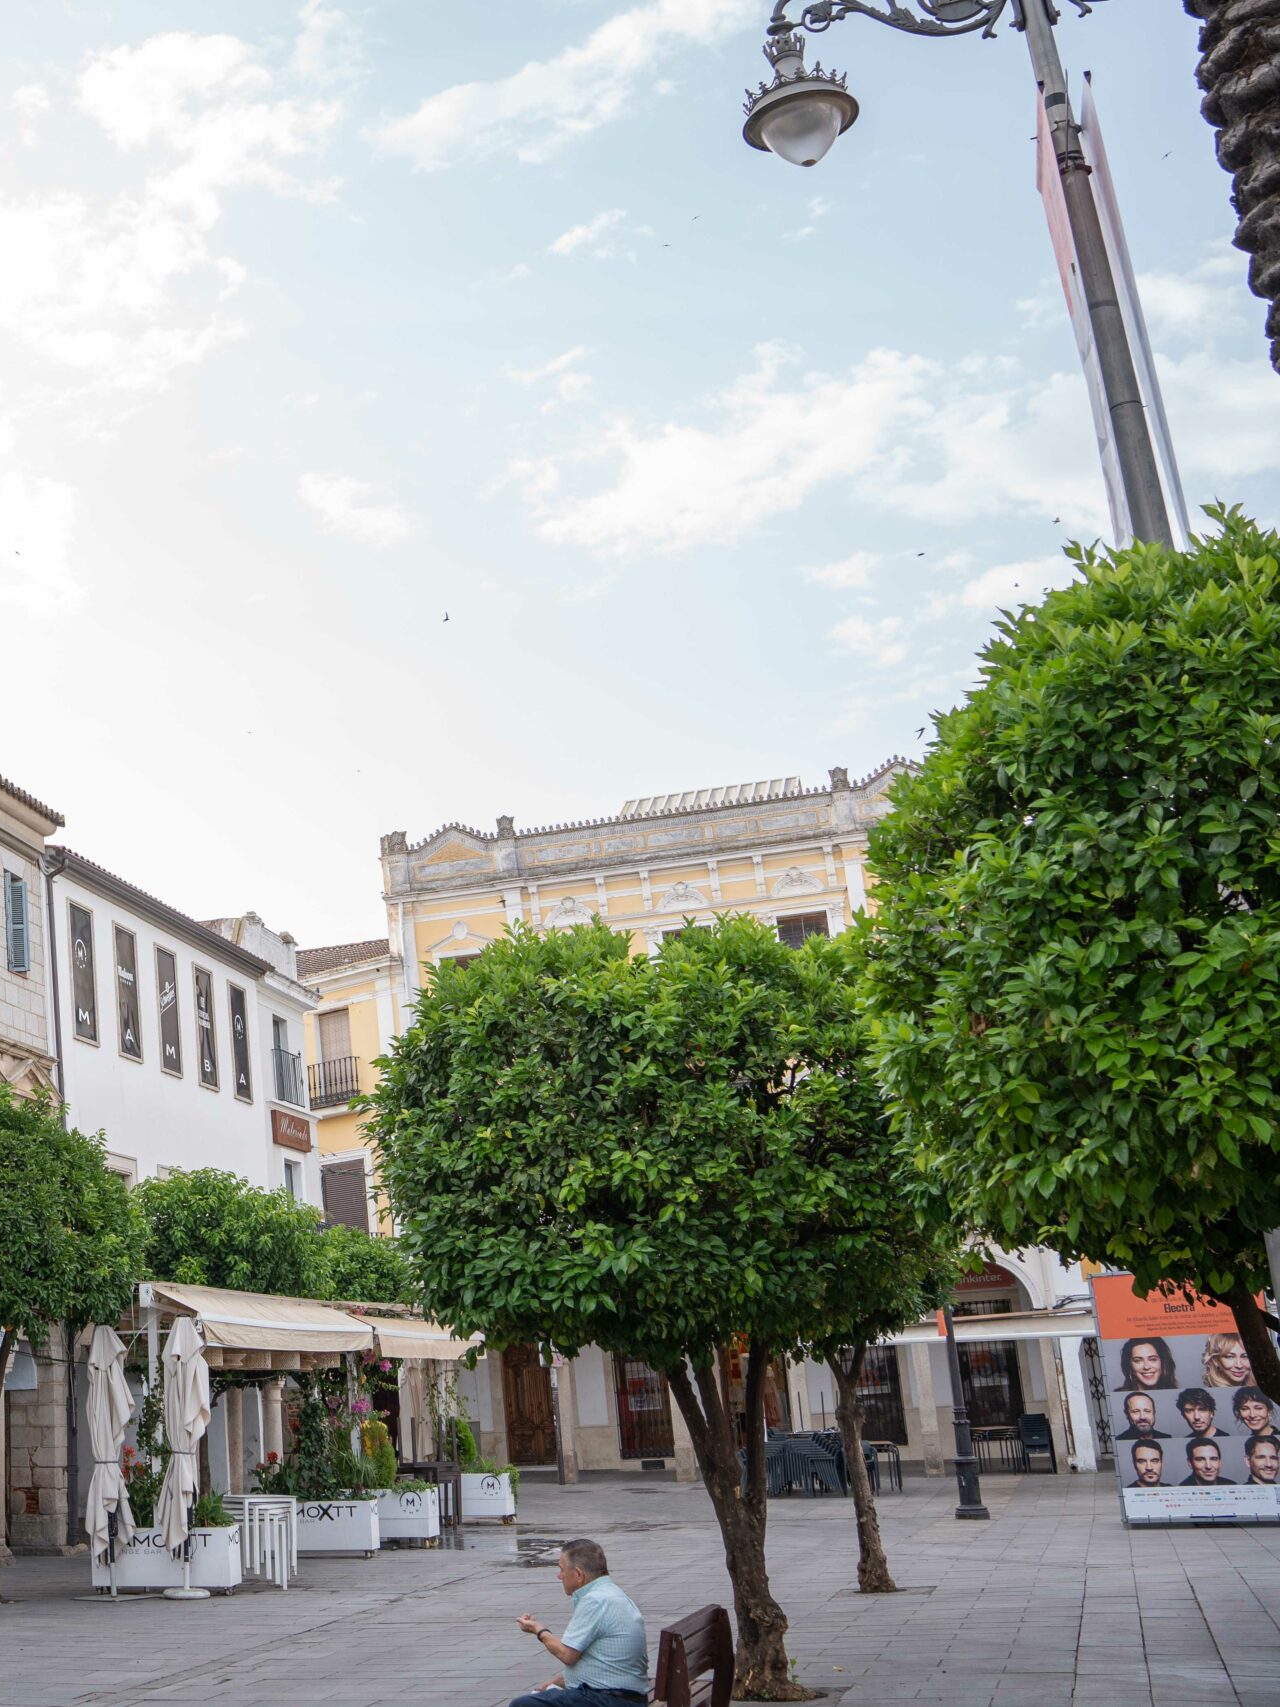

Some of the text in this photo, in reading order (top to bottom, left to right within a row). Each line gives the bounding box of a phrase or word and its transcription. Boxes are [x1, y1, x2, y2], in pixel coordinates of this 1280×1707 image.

[79, 1008, 246, 1085] M A M B A
